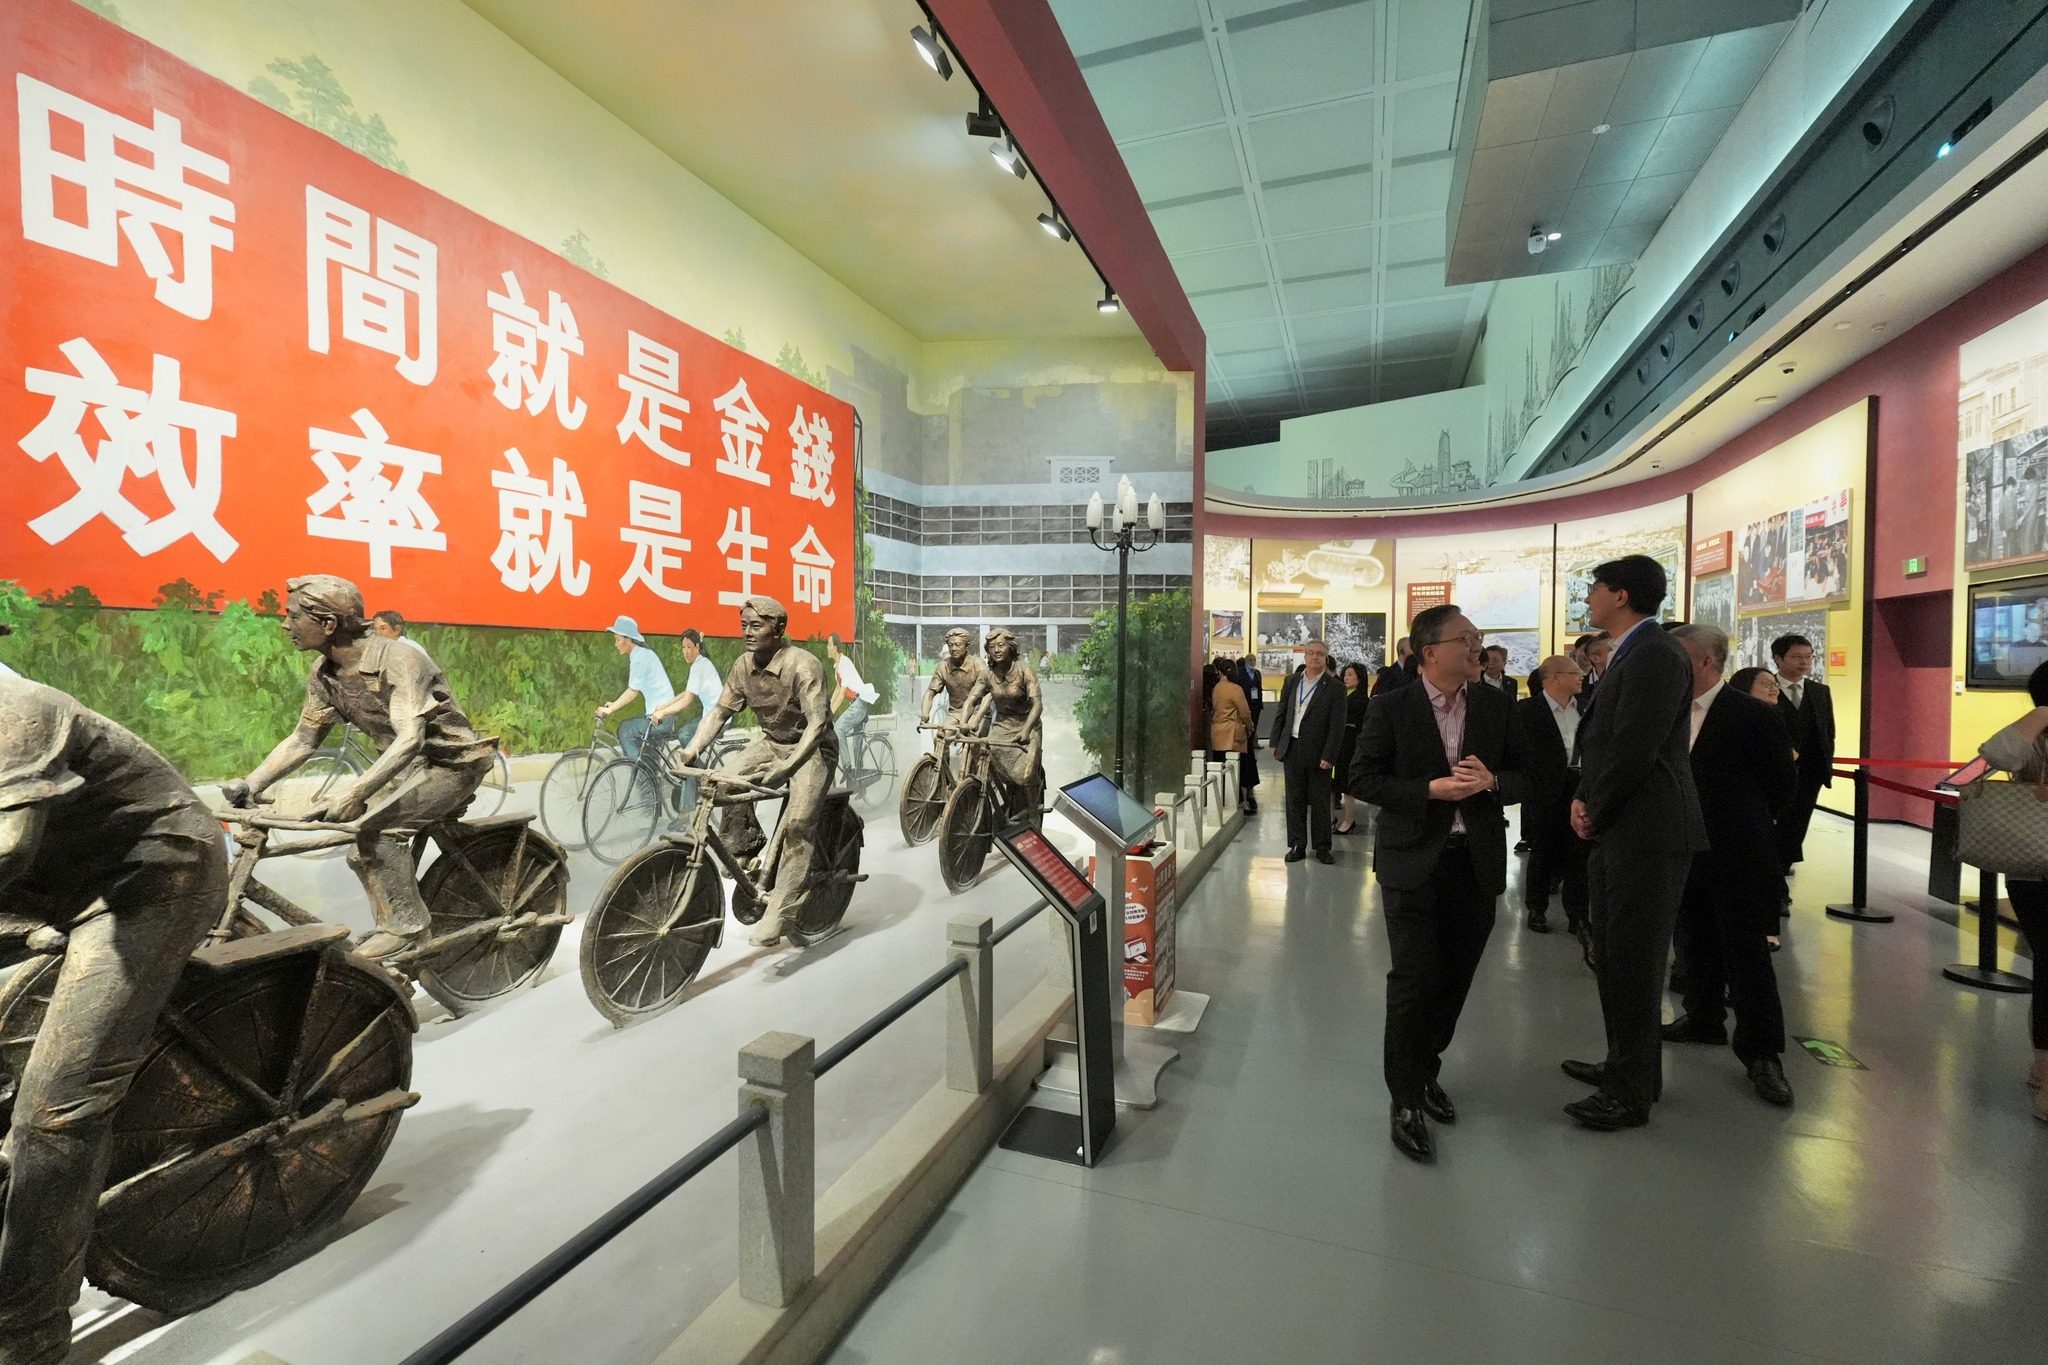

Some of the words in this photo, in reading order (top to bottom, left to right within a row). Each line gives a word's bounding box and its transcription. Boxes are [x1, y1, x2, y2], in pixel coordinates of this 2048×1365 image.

[16, 72, 836, 508] 時間就是金錢
[18, 337, 836, 613] 效率就是生命
